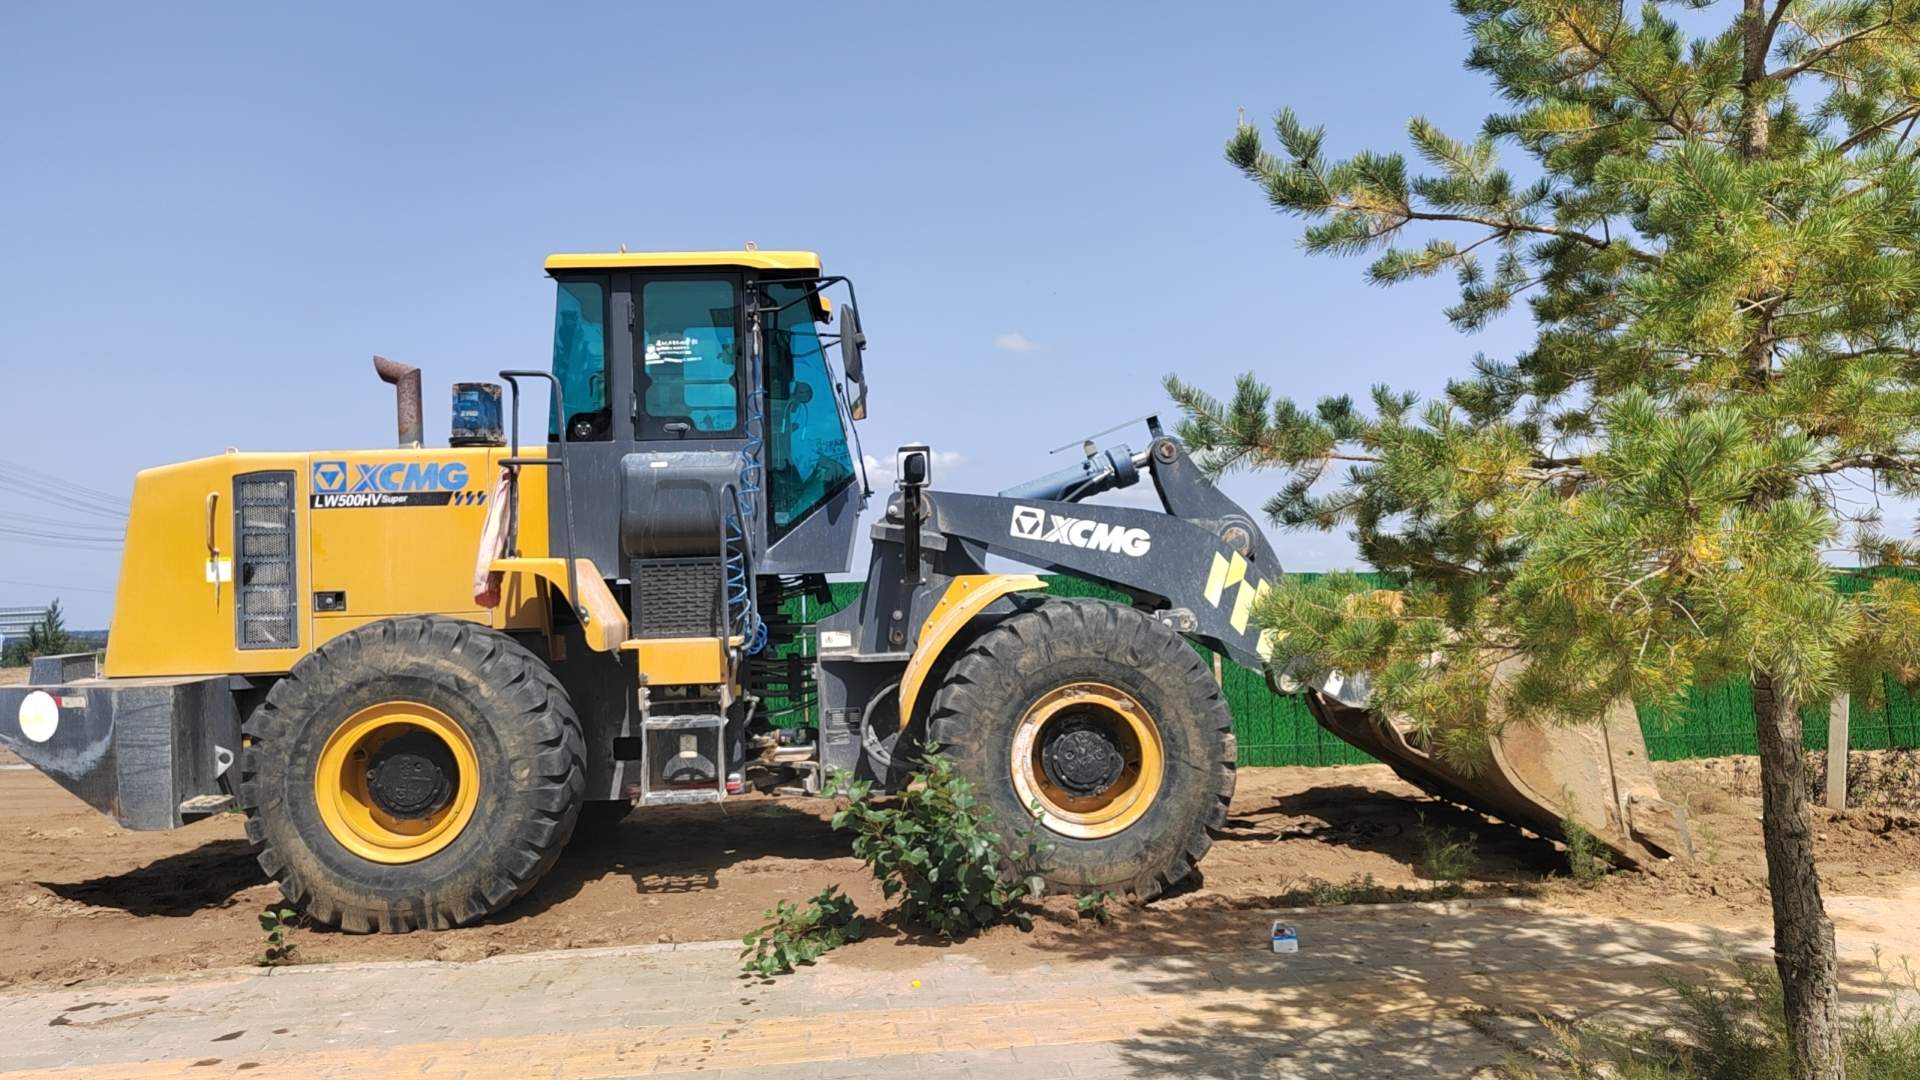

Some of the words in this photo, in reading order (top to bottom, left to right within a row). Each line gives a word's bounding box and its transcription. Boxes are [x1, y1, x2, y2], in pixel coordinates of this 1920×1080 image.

[351, 462, 469, 492] XCMG
[314, 493, 382, 508] LW500HV
[381, 494, 408, 504] Super
[1041, 514, 1151, 557] XCMG
